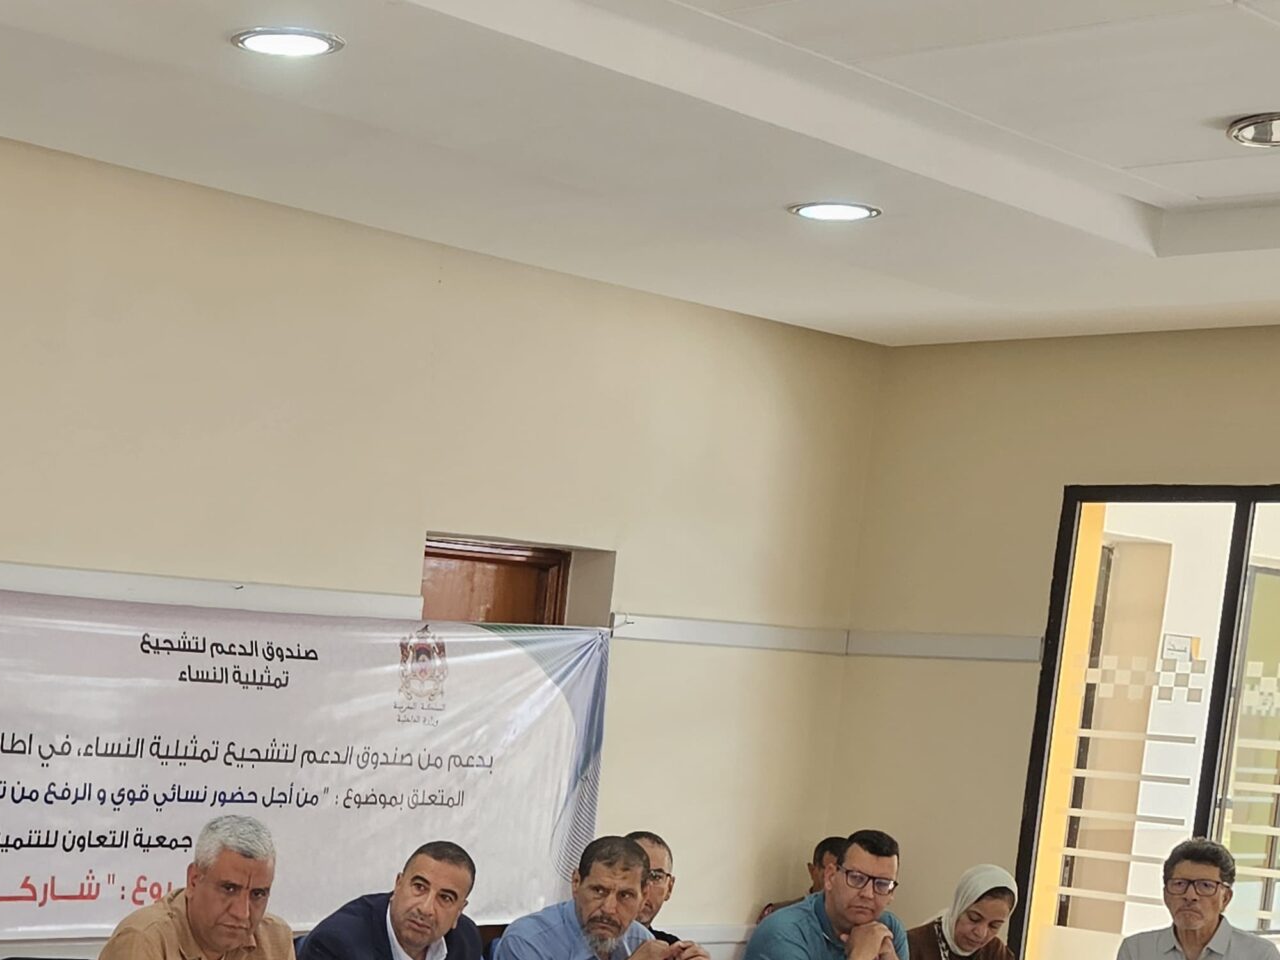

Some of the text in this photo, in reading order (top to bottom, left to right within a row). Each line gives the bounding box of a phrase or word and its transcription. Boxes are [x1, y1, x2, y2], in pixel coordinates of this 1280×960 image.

[140, 631, 319, 662] صندوق الدعم لتشجيع
[178, 664, 289, 690] تمثيلية النساء
[38, 734, 72, 768] في
[150, 735, 219, 767] تمثيلية
[223, 738, 297, 768] لتشجيع
[300, 745, 353, 768] الدعم
[356, 746, 413, 770] صندوق
[418, 748, 443, 769] من
[447, 750, 494, 775] بدعم
[10, 780, 39, 805] من
[44, 782, 92, 807] الرفع
[111, 785, 149, 812] قوي
[153, 784, 208, 812] نسائي
[210, 787, 258, 808] حضور
[261, 782, 294, 807] أجل
[296, 789, 319, 808] من
[342, 788, 404, 812] بموضوع
[407, 789, 464, 810] المتعلق
[62, 829, 129, 853] التعاون
[133, 829, 193, 852] جمعية
